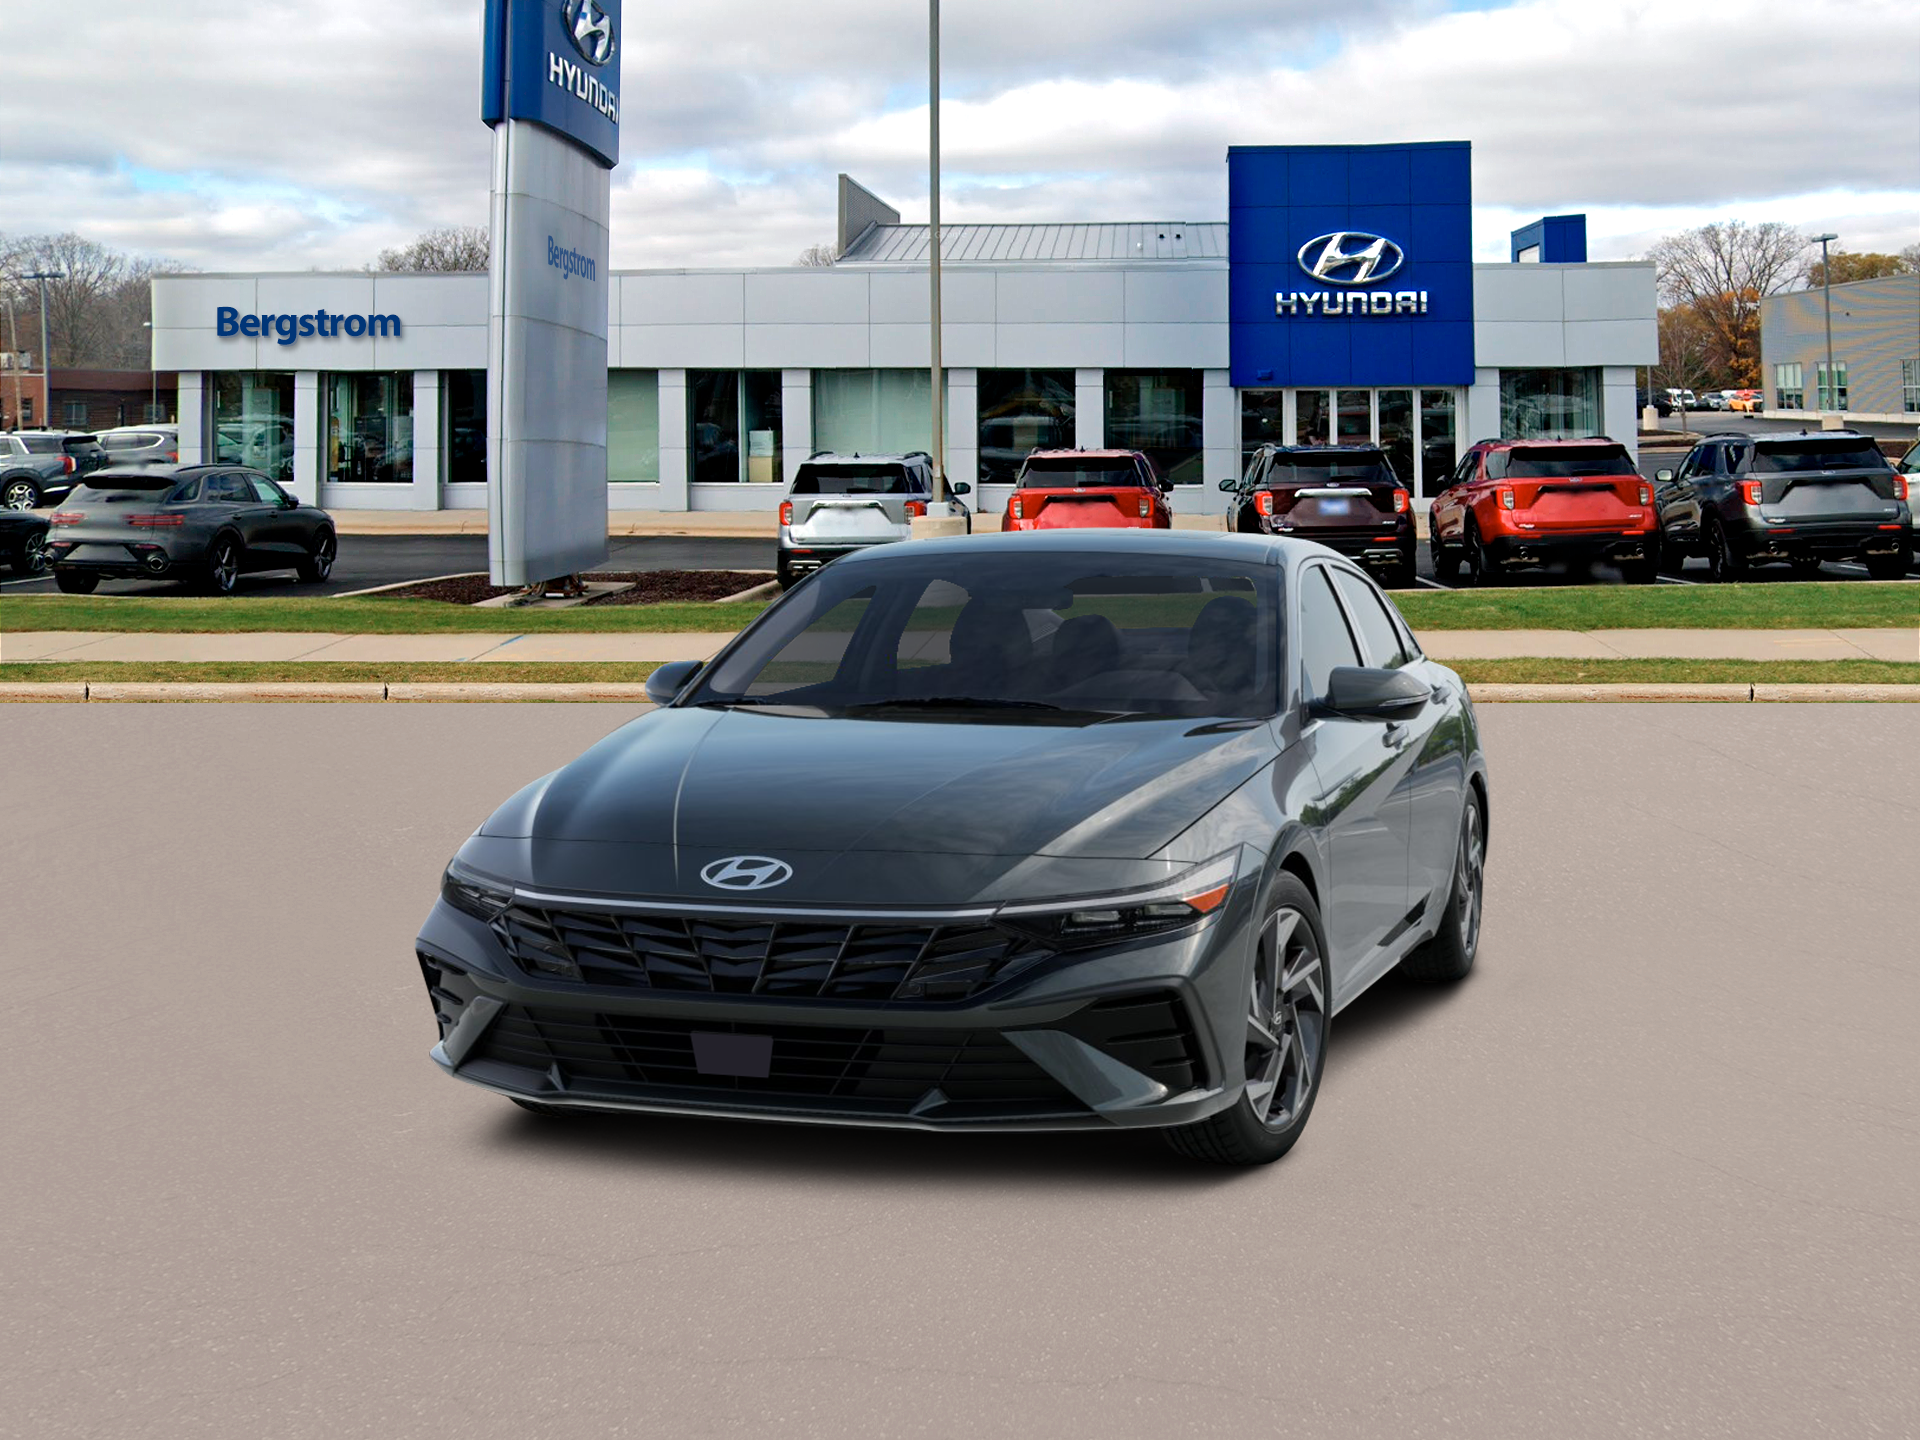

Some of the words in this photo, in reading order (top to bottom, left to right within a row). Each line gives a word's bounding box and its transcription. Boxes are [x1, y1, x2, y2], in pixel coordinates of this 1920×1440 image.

[549, 51, 619, 125] HYUNDAI
[547, 235, 596, 282] Bergstrom
[1275, 290, 1428, 316] HYUNDAI
[216, 306, 402, 346] Bergstrom
